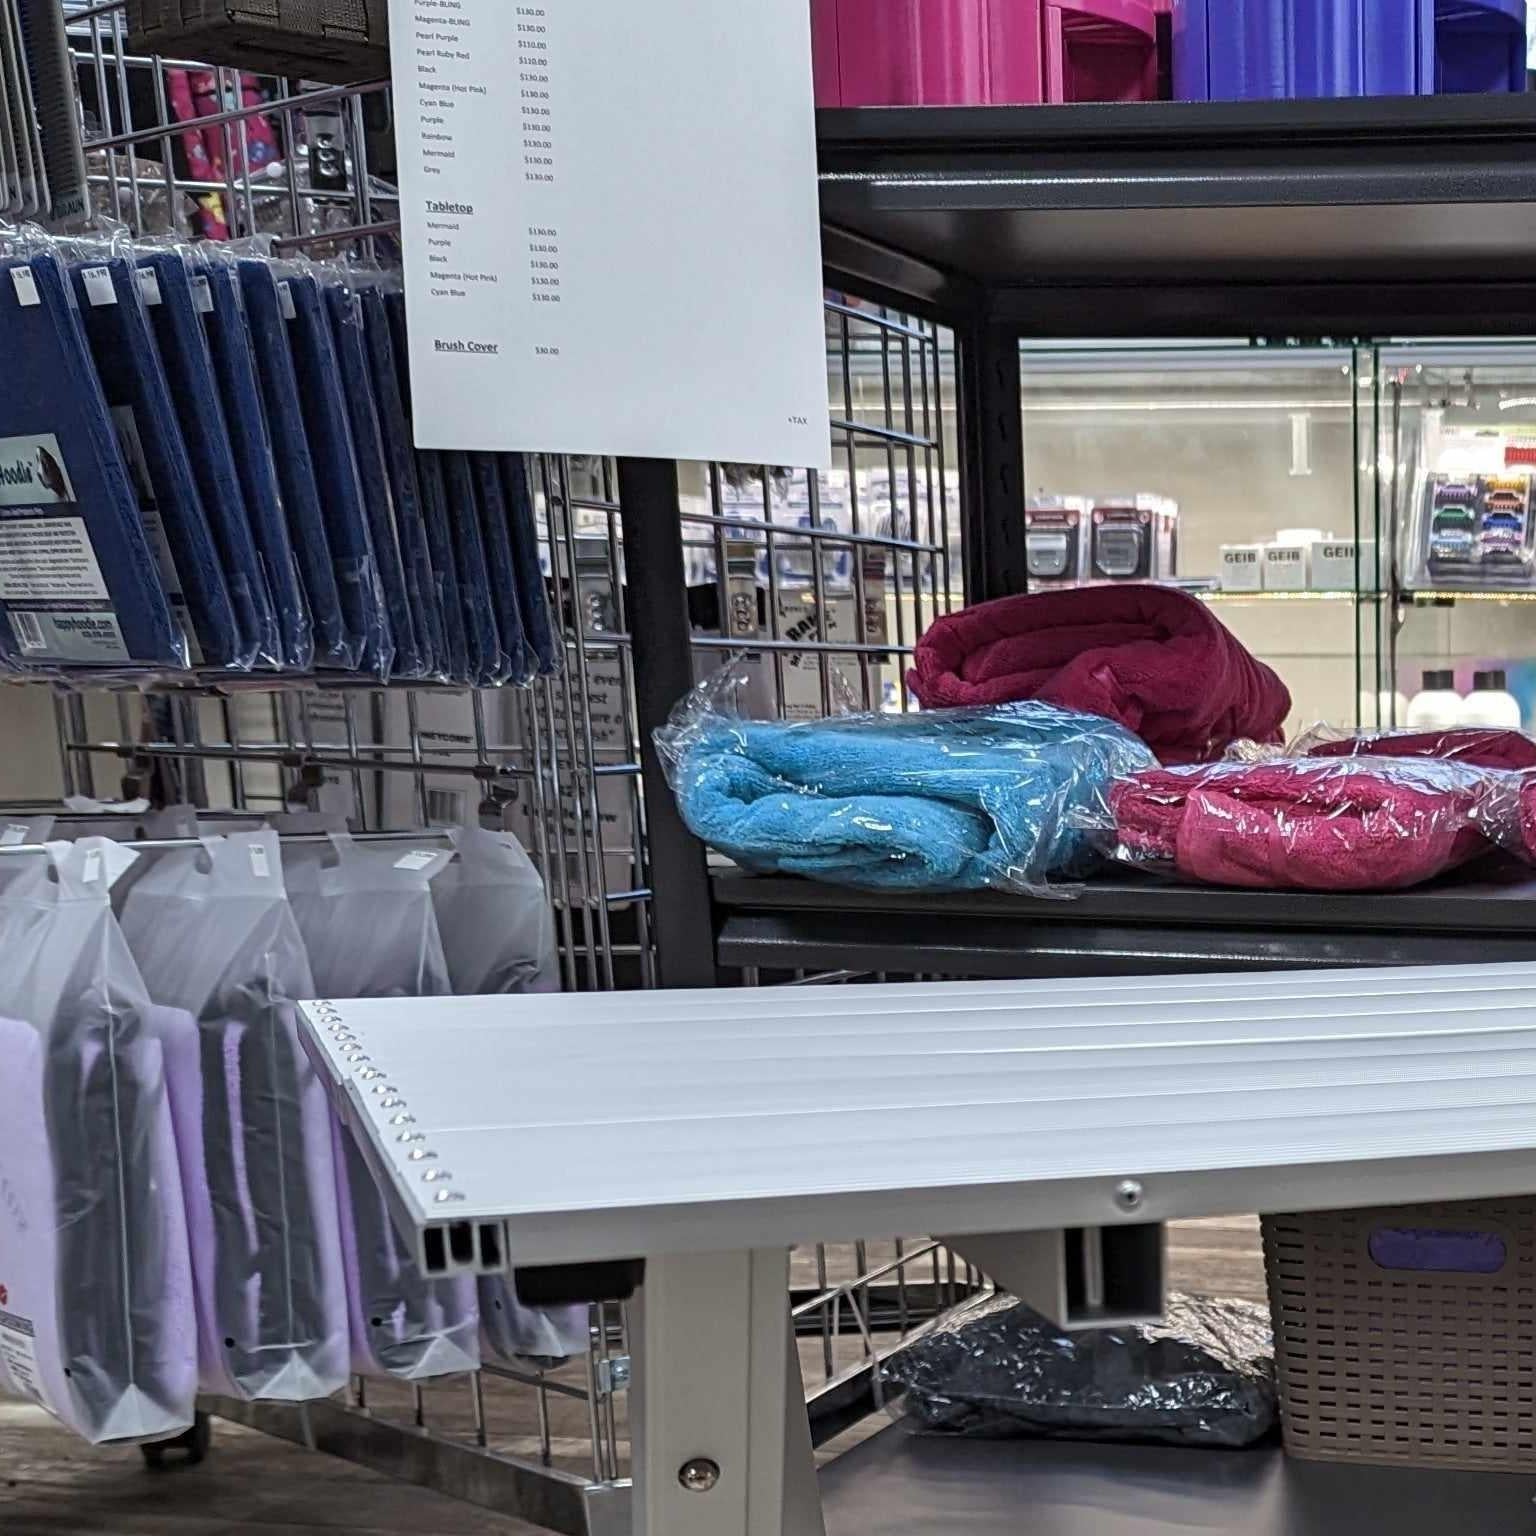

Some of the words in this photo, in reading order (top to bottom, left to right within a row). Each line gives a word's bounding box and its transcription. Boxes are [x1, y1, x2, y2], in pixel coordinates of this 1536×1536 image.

[426, 201, 473, 215] Tabletop
[434, 340, 465, 353] Brush
[467, 341, 498, 354] Cover
[1224, 552, 1256, 564] GEIB
[1267, 551, 1300, 562] GEIB
